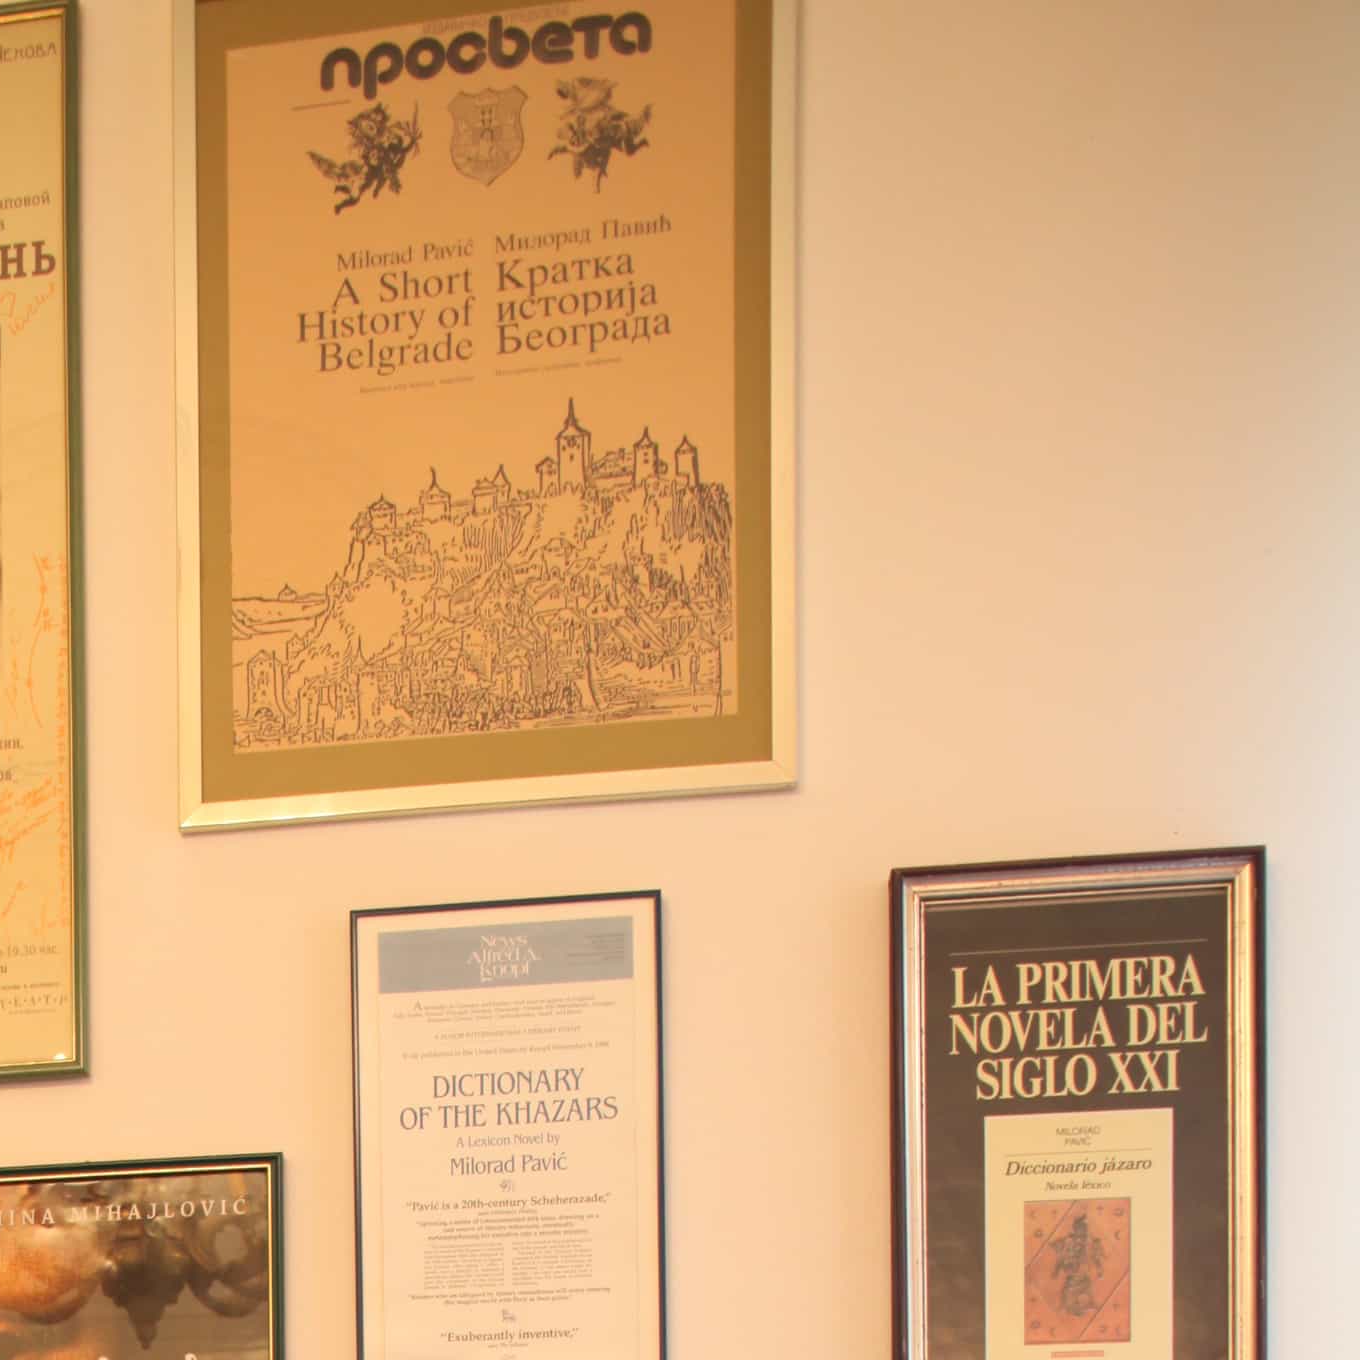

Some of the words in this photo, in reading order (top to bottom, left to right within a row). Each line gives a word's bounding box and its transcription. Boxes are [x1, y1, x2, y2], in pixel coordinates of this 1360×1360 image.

[320, 11, 653, 100] просвета
[494, 226, 591, 255] Милорад
[601, 213, 673, 240] Павић
[335, 245, 413, 273] Milorad
[422, 238, 474, 263] Pavić
[495, 250, 635, 296] Кратка
[332, 276, 361, 308] A
[378, 266, 473, 303] Short
[495, 281, 659, 324] историја
[296, 306, 425, 343] History
[437, 295, 476, 330] of
[495, 311, 672, 356] Београда
[318, 332, 474, 376] Belgrade
[951, 963, 1008, 1009] LA
[1015, 952, 1207, 1005] PRIMERA
[948, 1004, 1117, 1055] NOVELA
[1125, 1000, 1209, 1047] DEL
[432, 1067, 585, 1099] DICTIONARY
[975, 1052, 1098, 1101] SIGLO
[1107, 1048, 1182, 1095] XXI
[399, 1105, 433, 1131] OF
[438, 1103, 487, 1129] THE
[495, 1095, 619, 1127] KHAZARS
[455, 1137, 466, 1149] A
[467, 1133, 511, 1148] Lexicon
[513, 1130, 544, 1146] Novel
[546, 1129, 561, 1146] by
[449, 1154, 516, 1177] Milorad
[521, 1150, 569, 1173] Pavić
[1005, 1156, 1097, 1177] Diccionario
[1098, 1156, 1153, 1176] jázaro
[69, 1189, 249, 1224] MIHAJLOVIĆ
